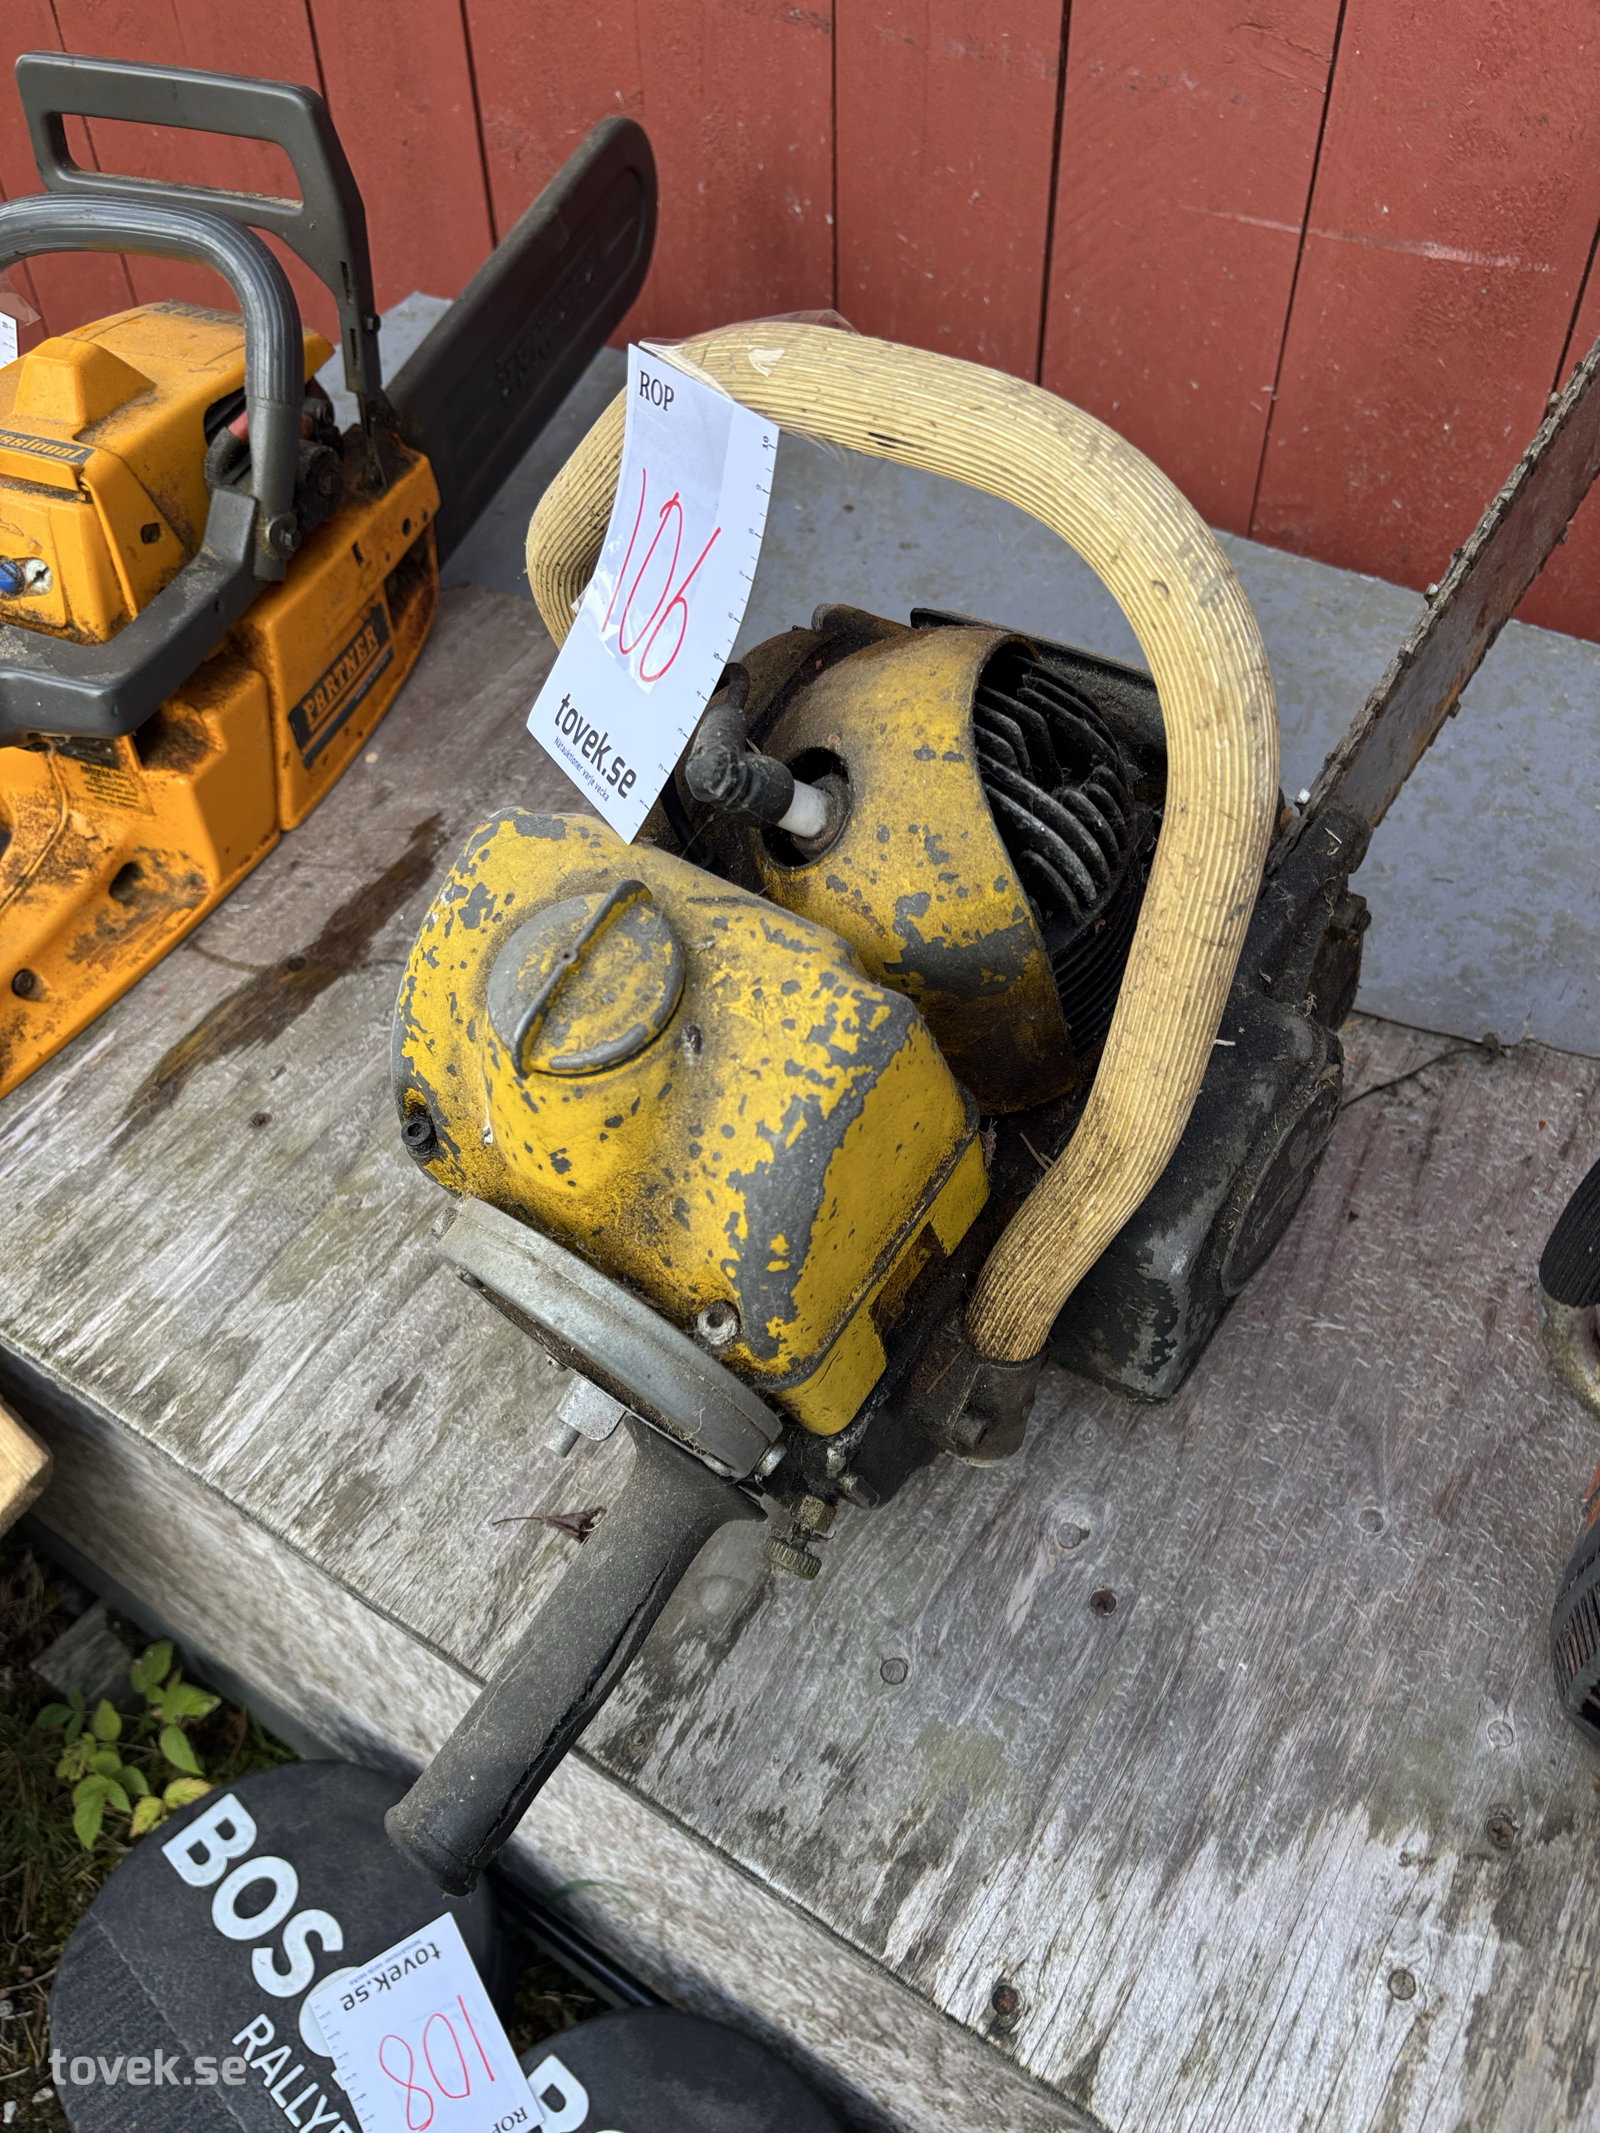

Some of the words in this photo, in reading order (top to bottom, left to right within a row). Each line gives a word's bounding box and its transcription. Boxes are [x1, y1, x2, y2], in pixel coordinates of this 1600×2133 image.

[639, 371, 675, 412] ROP
[602, 468, 722, 682] 106
[302, 624, 380, 718] PARTNER
[555, 693, 637, 799] tovek.se
[594, 783, 610, 802] vecka
[161, 1793, 362, 2093] BOS
[340, 1942, 440, 2011] tovek.se
[231, 2013, 354, 2133] RALLY
[379, 1994, 495, 2132] 108
